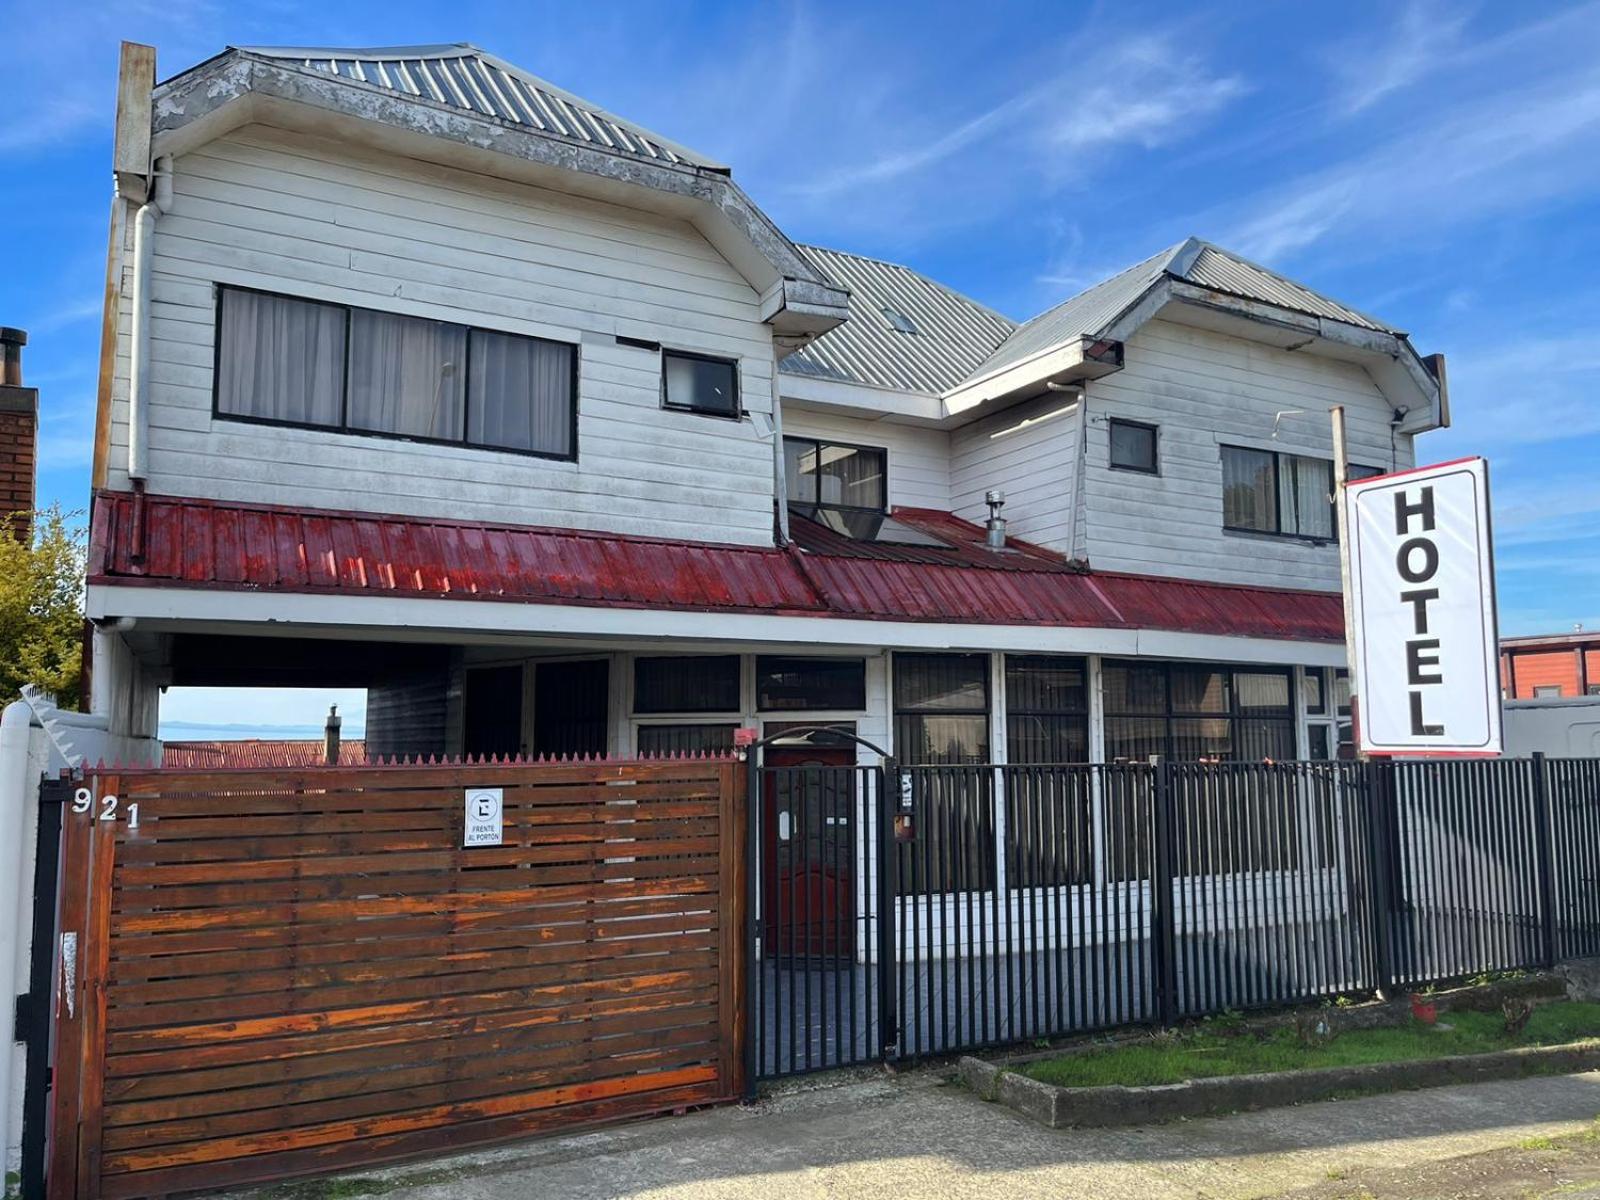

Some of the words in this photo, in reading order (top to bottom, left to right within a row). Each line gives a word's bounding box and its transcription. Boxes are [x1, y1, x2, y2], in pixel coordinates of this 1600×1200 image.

[1394, 486, 1445, 736] HOTEL
[72, 788, 138, 828] 921
[472, 824, 495, 832] FRENTE
